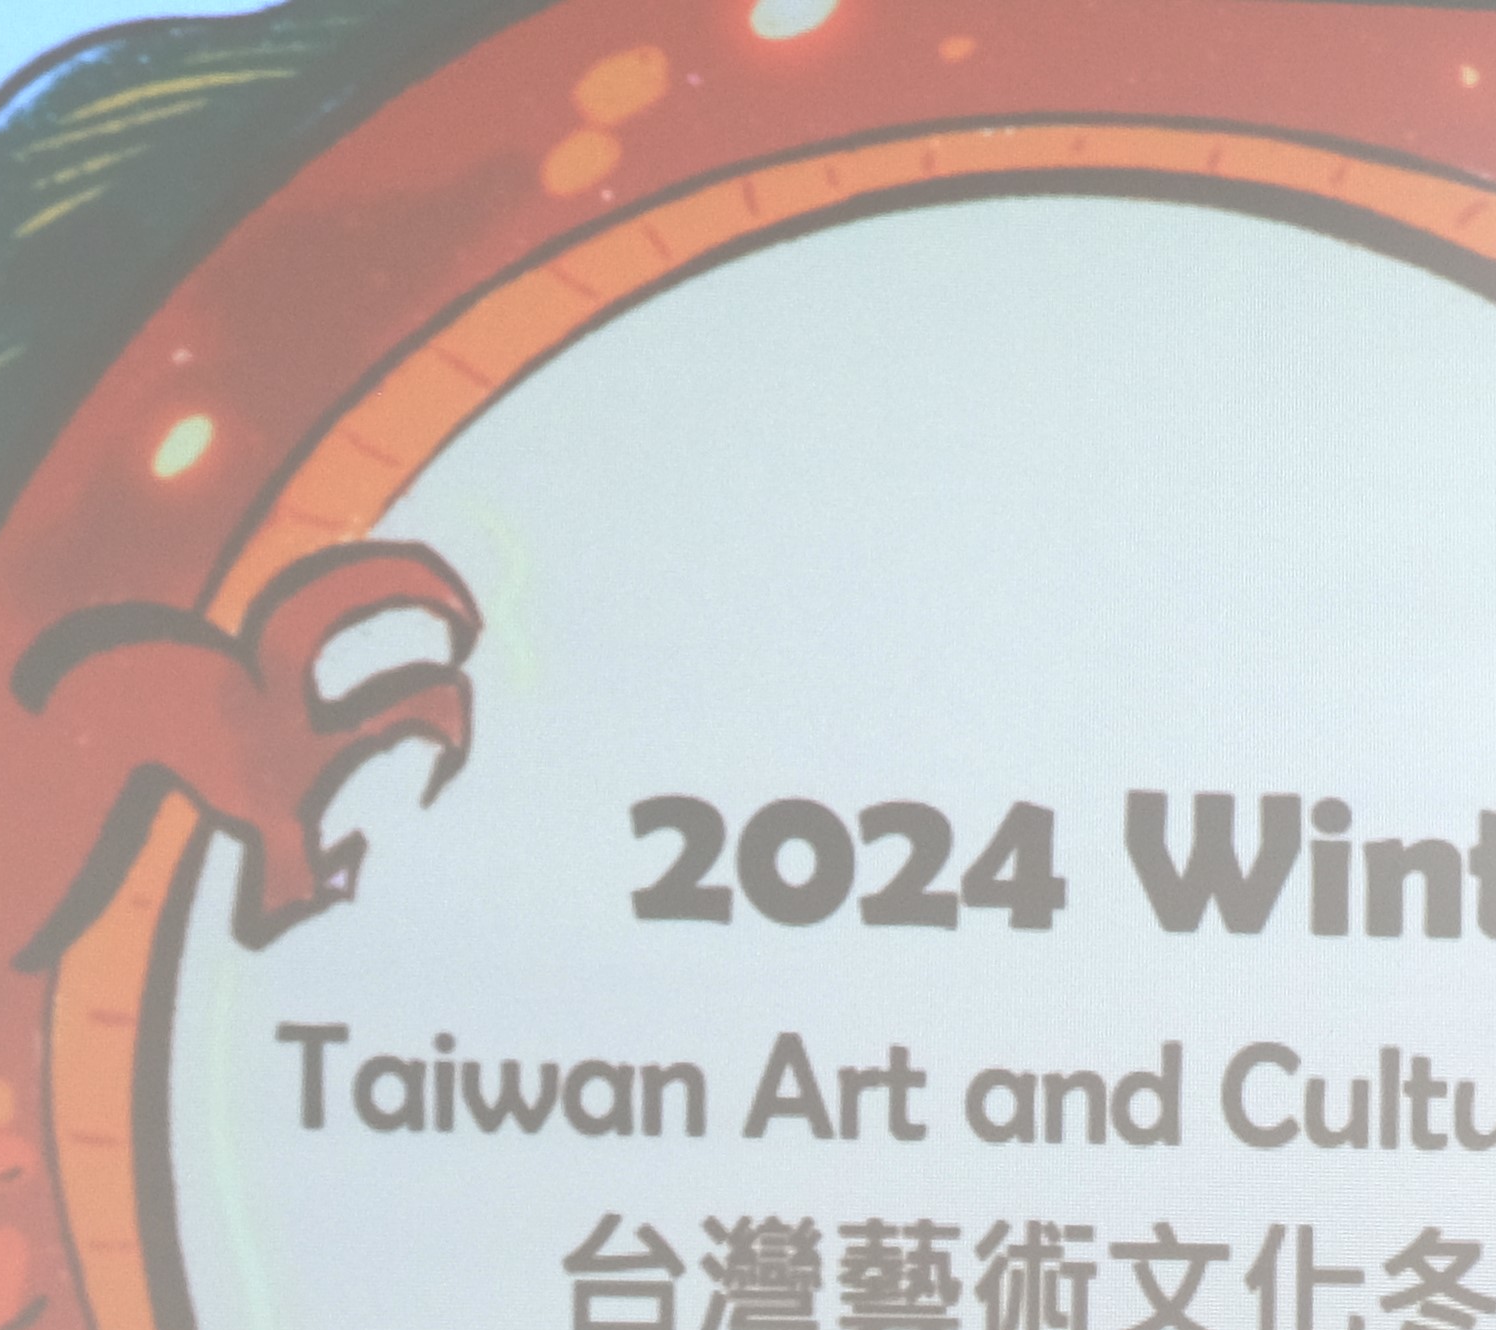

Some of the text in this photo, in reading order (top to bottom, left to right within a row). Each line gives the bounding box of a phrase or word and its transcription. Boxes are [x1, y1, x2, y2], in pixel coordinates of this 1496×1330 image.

[629, 793, 1067, 931] 2024
[274, 1021, 707, 1139] Taiwan
[742, 1031, 928, 1143] Art
[964, 1041, 1183, 1147] and
